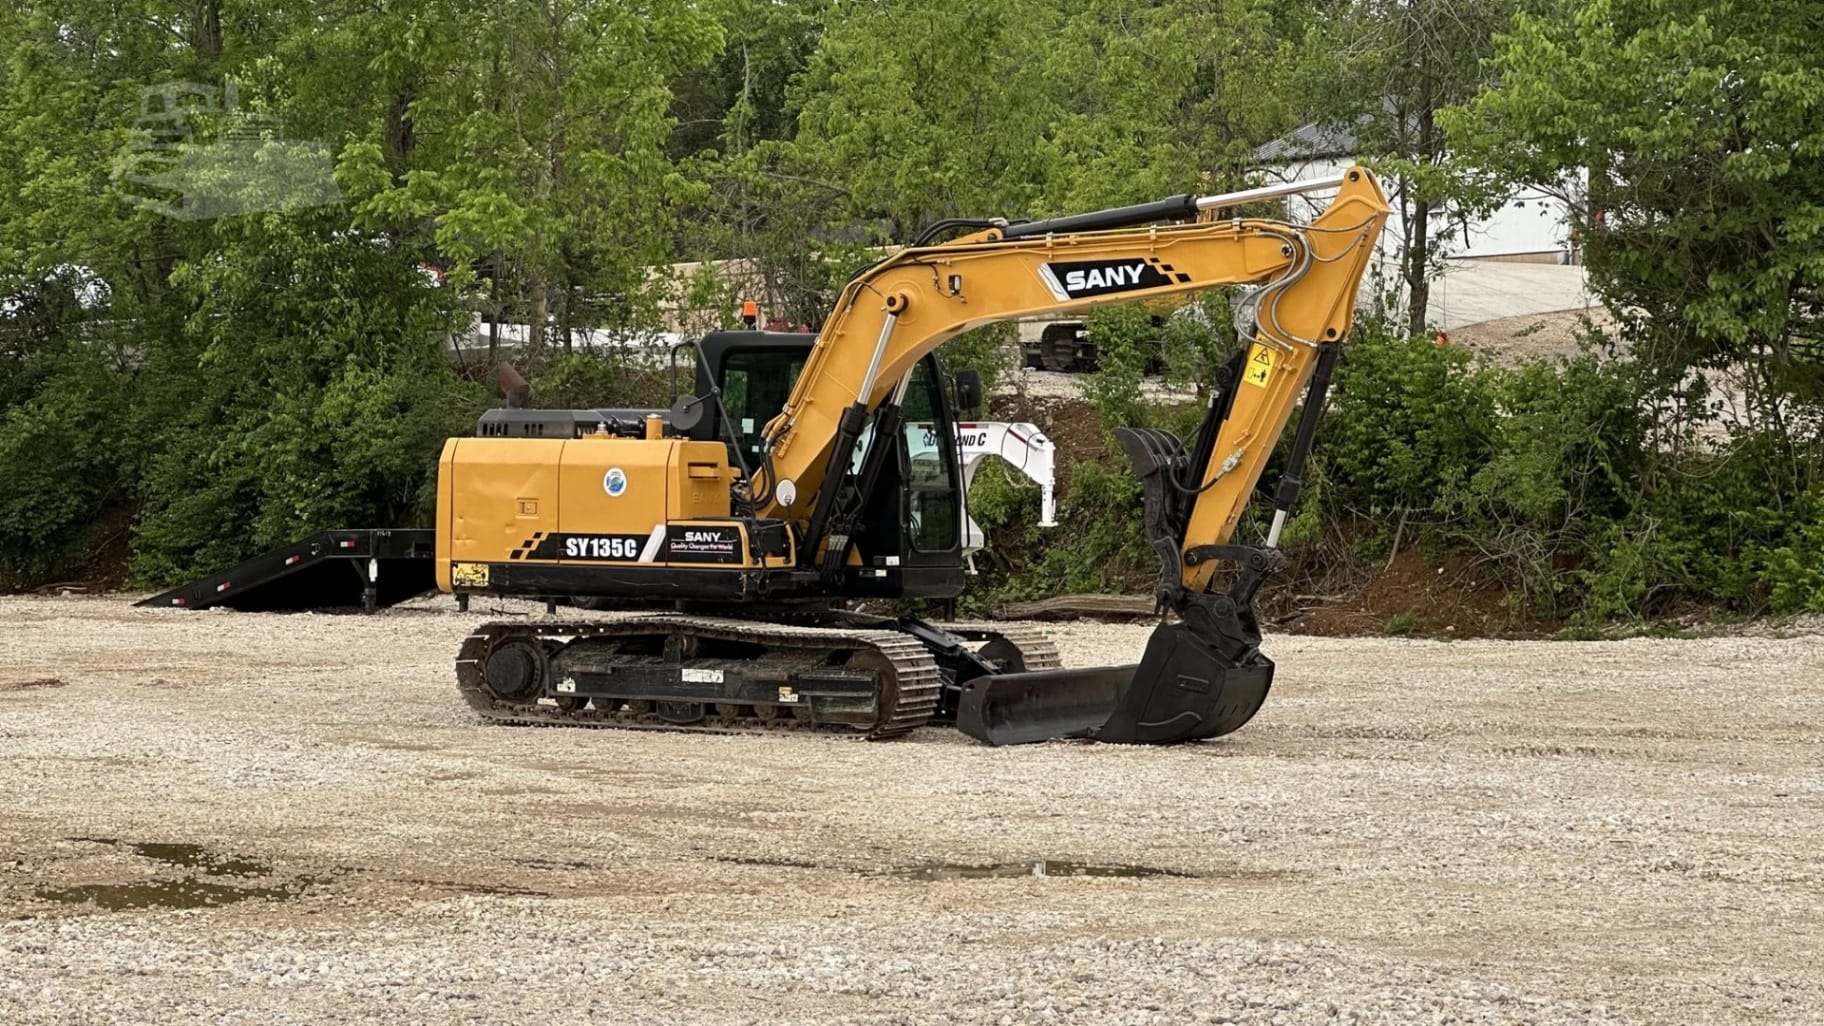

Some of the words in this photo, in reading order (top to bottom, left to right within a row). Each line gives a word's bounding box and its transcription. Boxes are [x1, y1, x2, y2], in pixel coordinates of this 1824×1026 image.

[1066, 263, 1145, 291] SANY
[977, 432, 987, 447] C
[685, 531, 721, 542] SANY
[565, 537, 637, 558] SY135C
